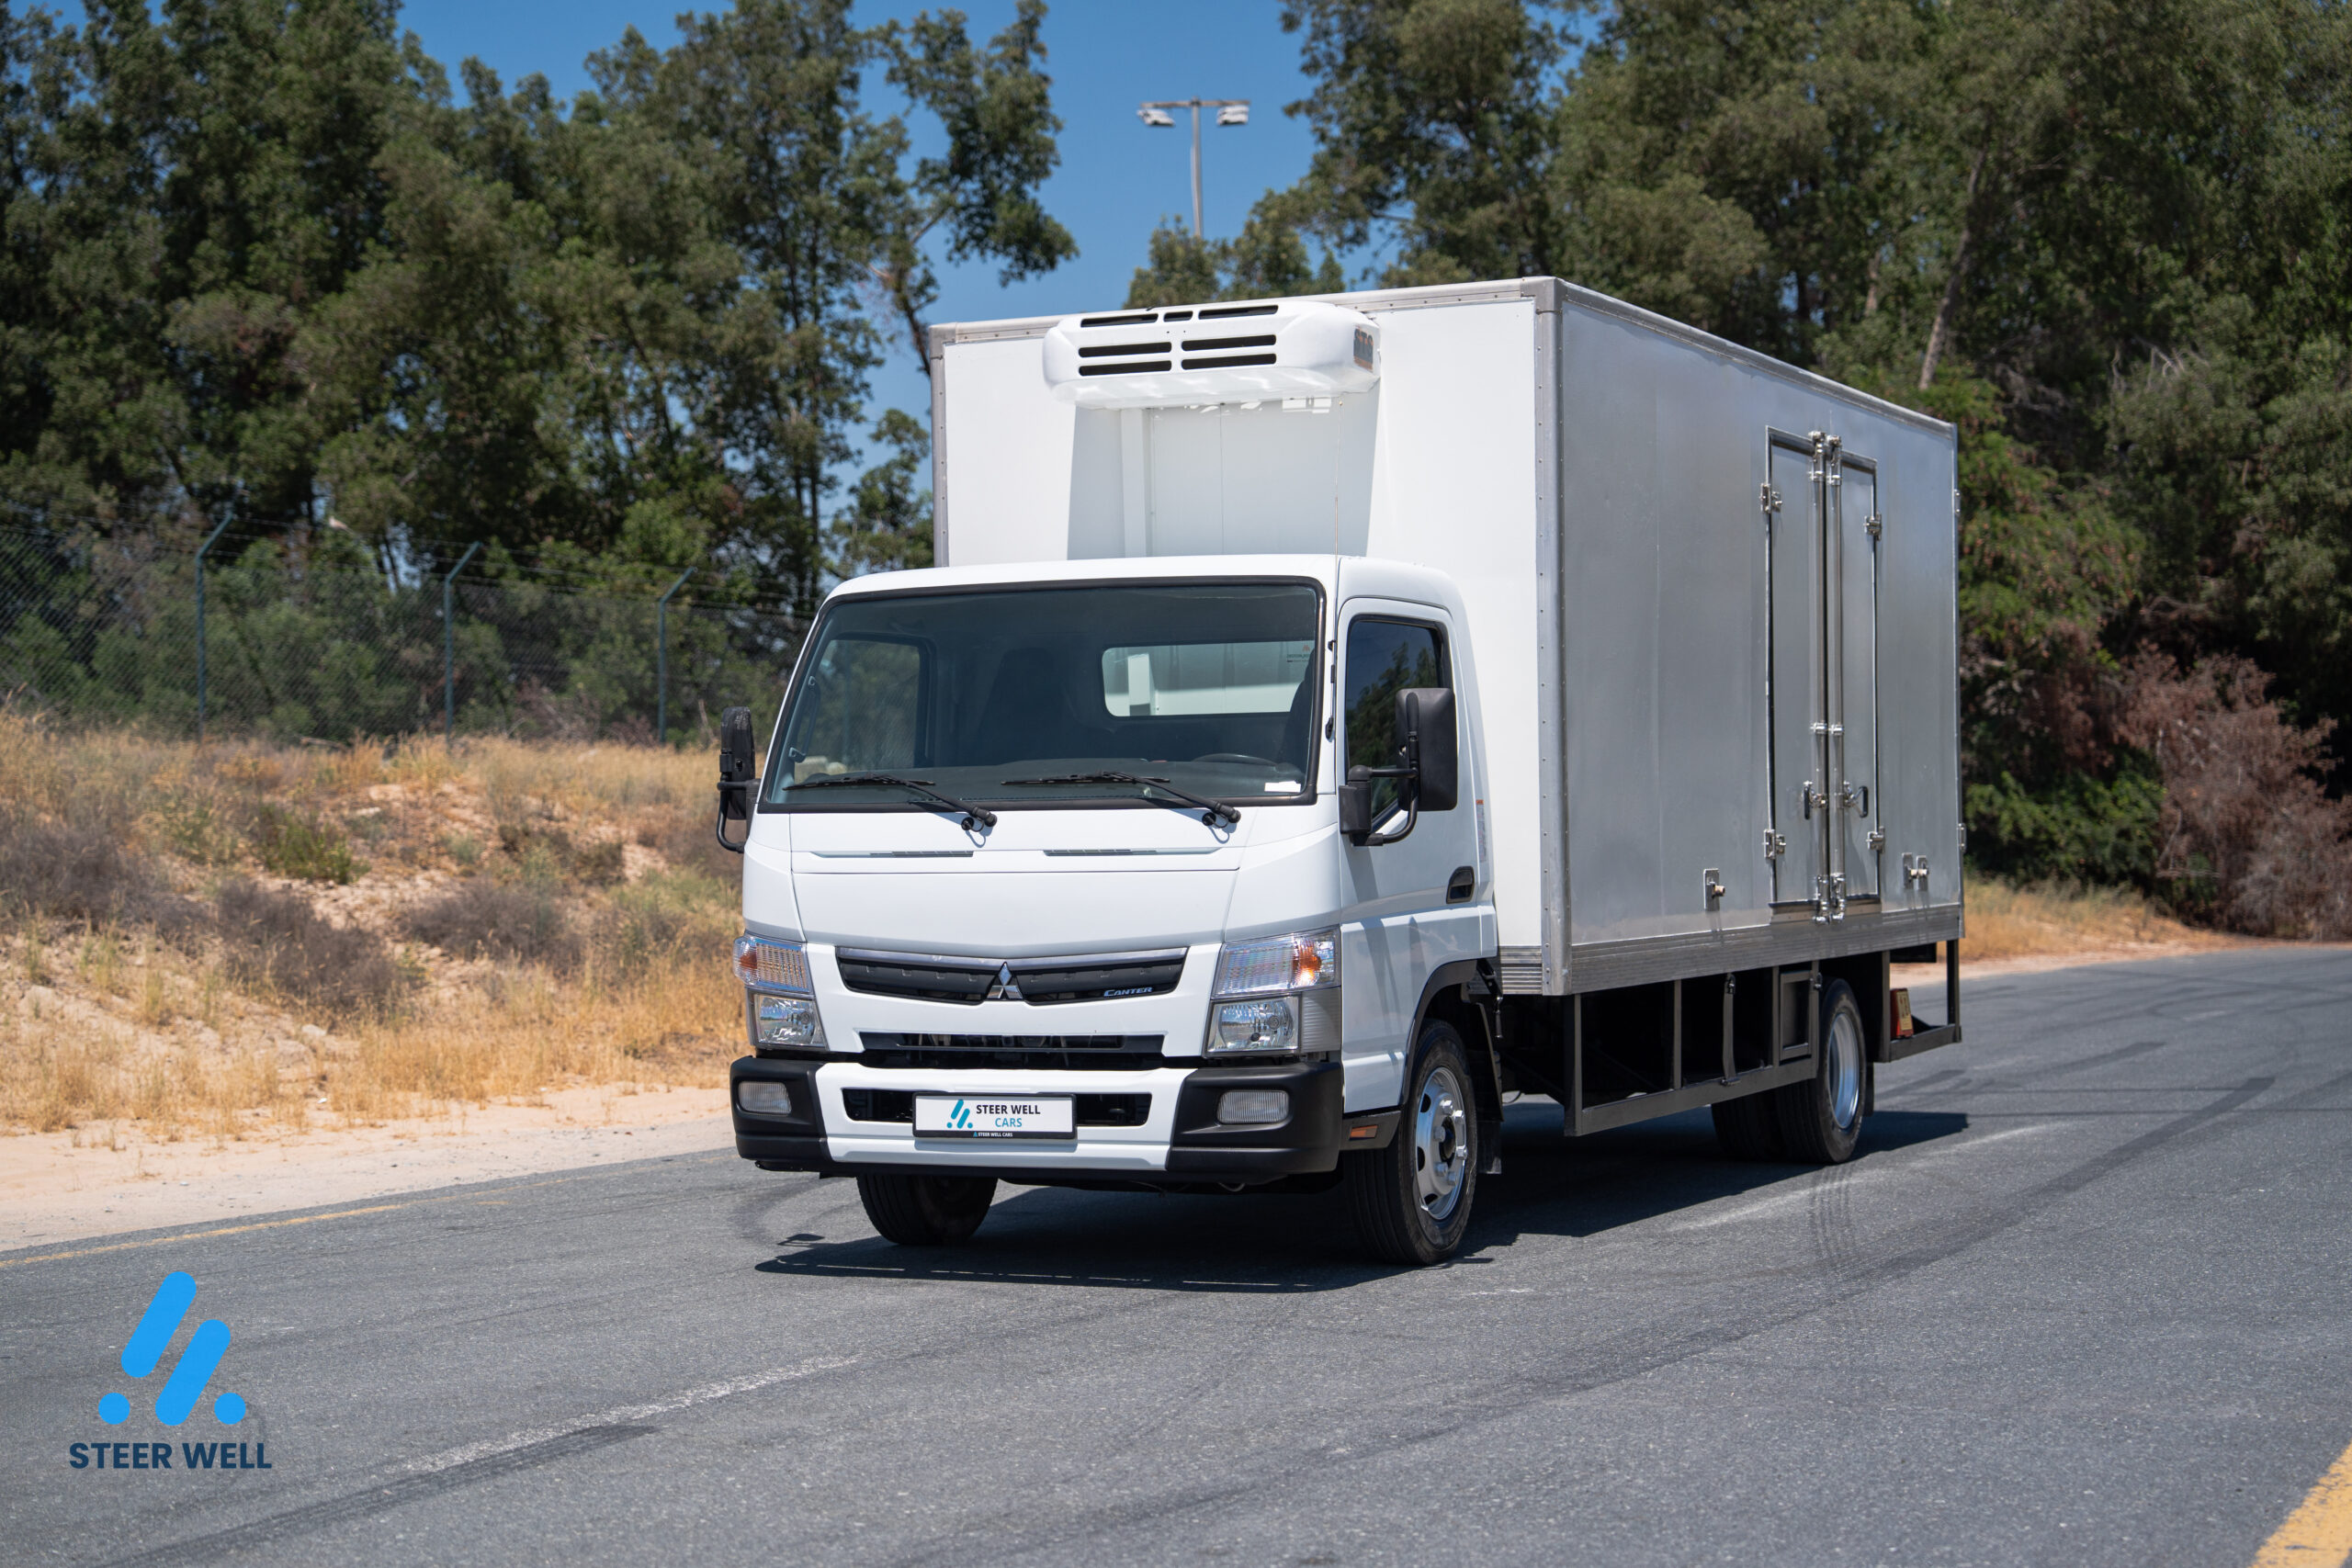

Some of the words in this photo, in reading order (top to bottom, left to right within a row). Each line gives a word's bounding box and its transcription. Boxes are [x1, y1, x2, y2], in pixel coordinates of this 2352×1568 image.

[1103, 987, 1153, 998] CANTER
[976, 1104, 1008, 1114] STEER
[1011, 1105, 1041, 1114] WELL
[994, 1117, 1023, 1128] CARS
